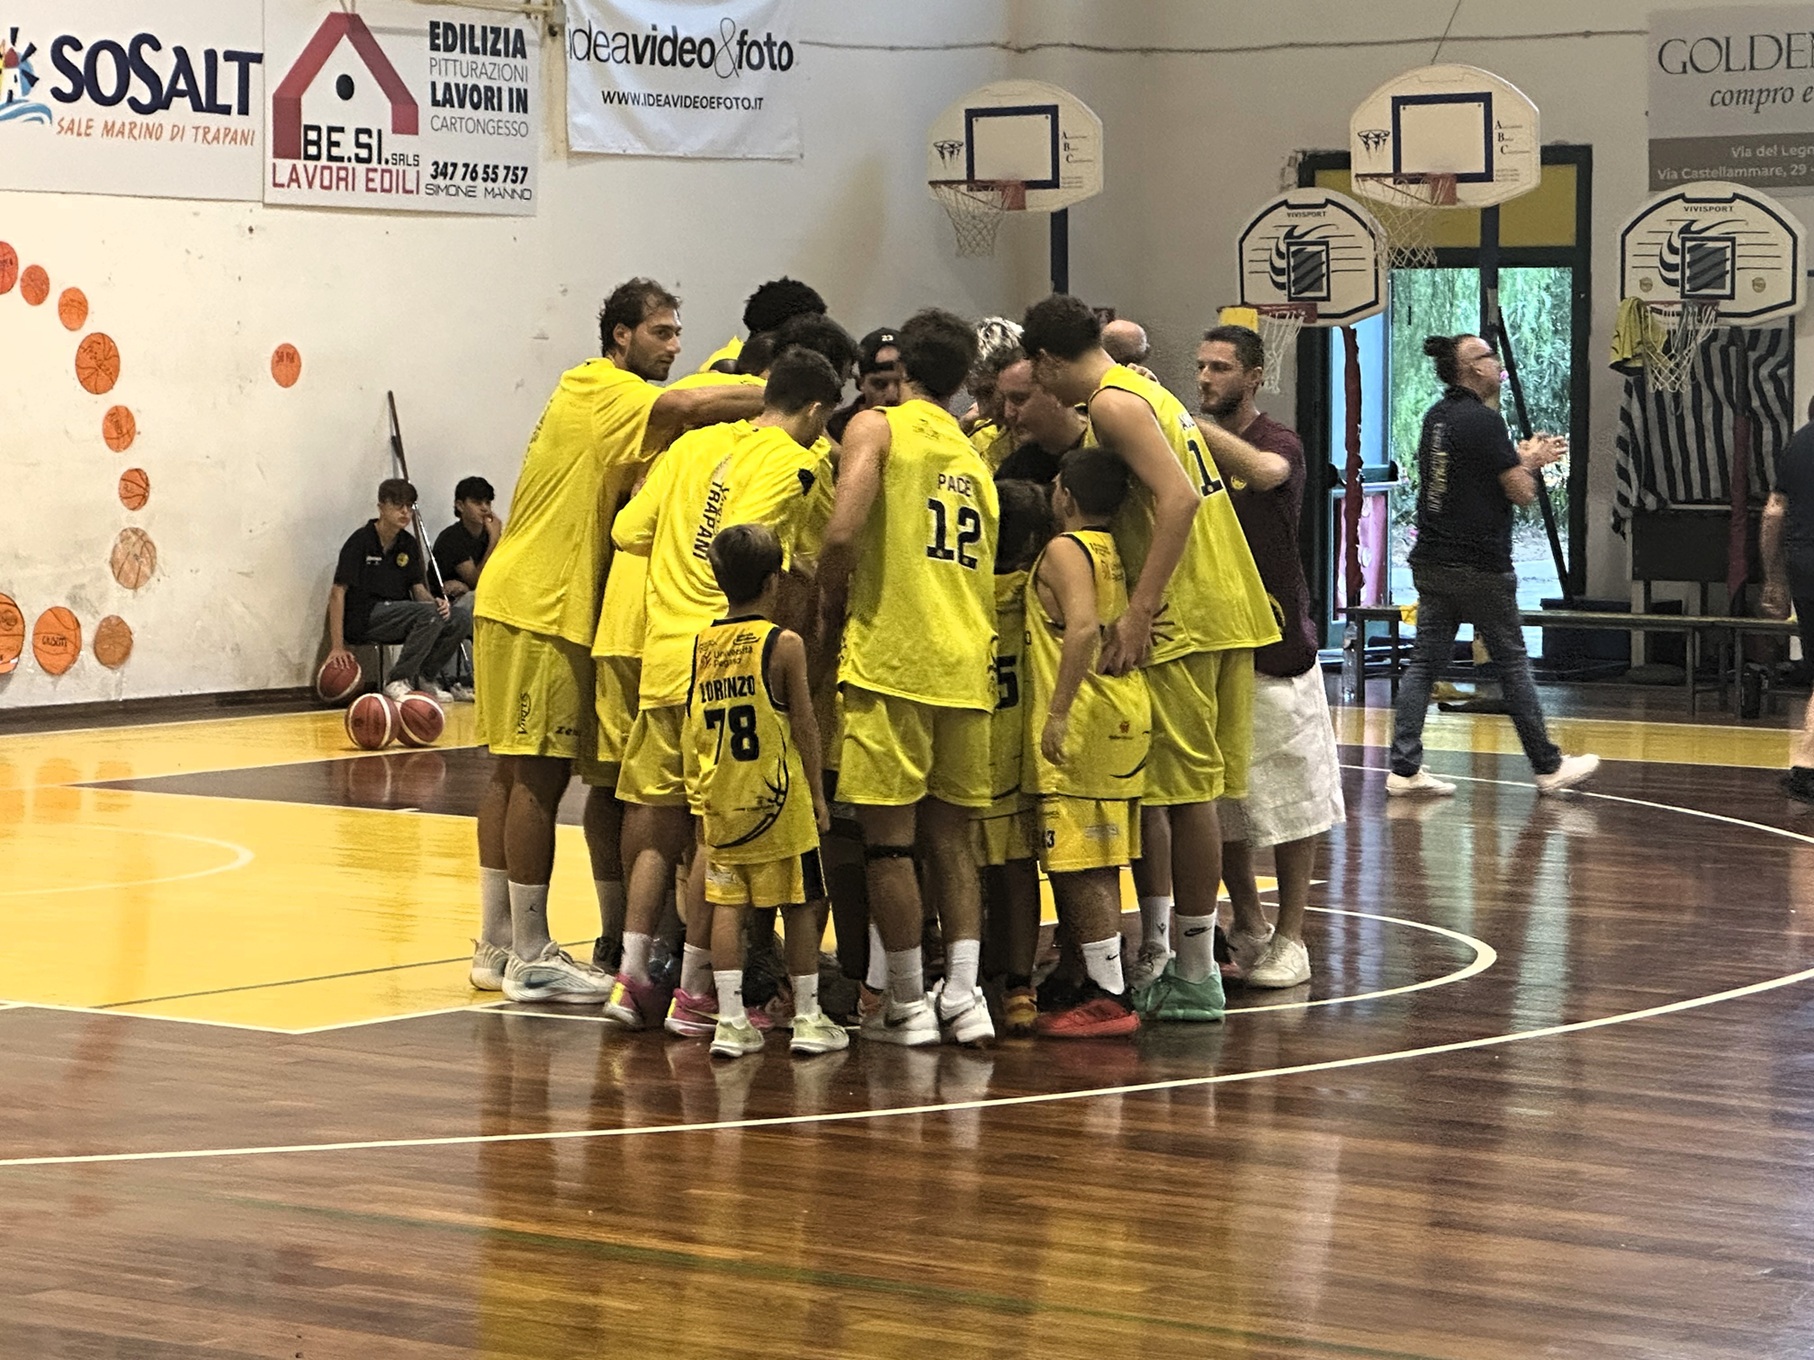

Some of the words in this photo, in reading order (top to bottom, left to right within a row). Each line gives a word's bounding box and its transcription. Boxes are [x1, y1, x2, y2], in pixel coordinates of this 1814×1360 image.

[429, 20, 527, 59] EDILIZIA
[50, 33, 264, 116] SOSALT
[429, 57, 528, 83] PITTURAZIONI
[430, 81, 502, 112] LAVORI
[508, 86, 528, 114] IN
[601, 90, 763, 111] WWW.IDEAVIDEOEFOTO.IT
[1710, 86, 1794, 114] compro
[56, 117, 94, 137] SALE
[101, 120, 163, 141] MARINO
[169, 124, 185, 141] DI
[192, 126, 255, 146] TRAPANI
[430, 114, 529, 138] CARTONGESSO
[1731, 146, 1752, 158] Via
[1756, 144, 1777, 157] del
[272, 162, 355, 191] LAVORI
[365, 167, 420, 195] EDILI
[430, 160, 458, 180] 347
[461, 162, 479, 182] 76
[481, 164, 499, 183] 55
[502, 165, 529, 184] 757
[1658, 169, 1678, 180] Via
[1681, 165, 1787, 179] Castellammare,
[1790, 164, 1807, 175] 29
[425, 183, 477, 198] SIMONE
[484, 186, 532, 200] MANNO
[937, 473, 971, 497] PACE
[692, 480, 724, 560] TRAPANI
[926, 497, 981, 570] 12
[704, 704, 760, 766] 78
